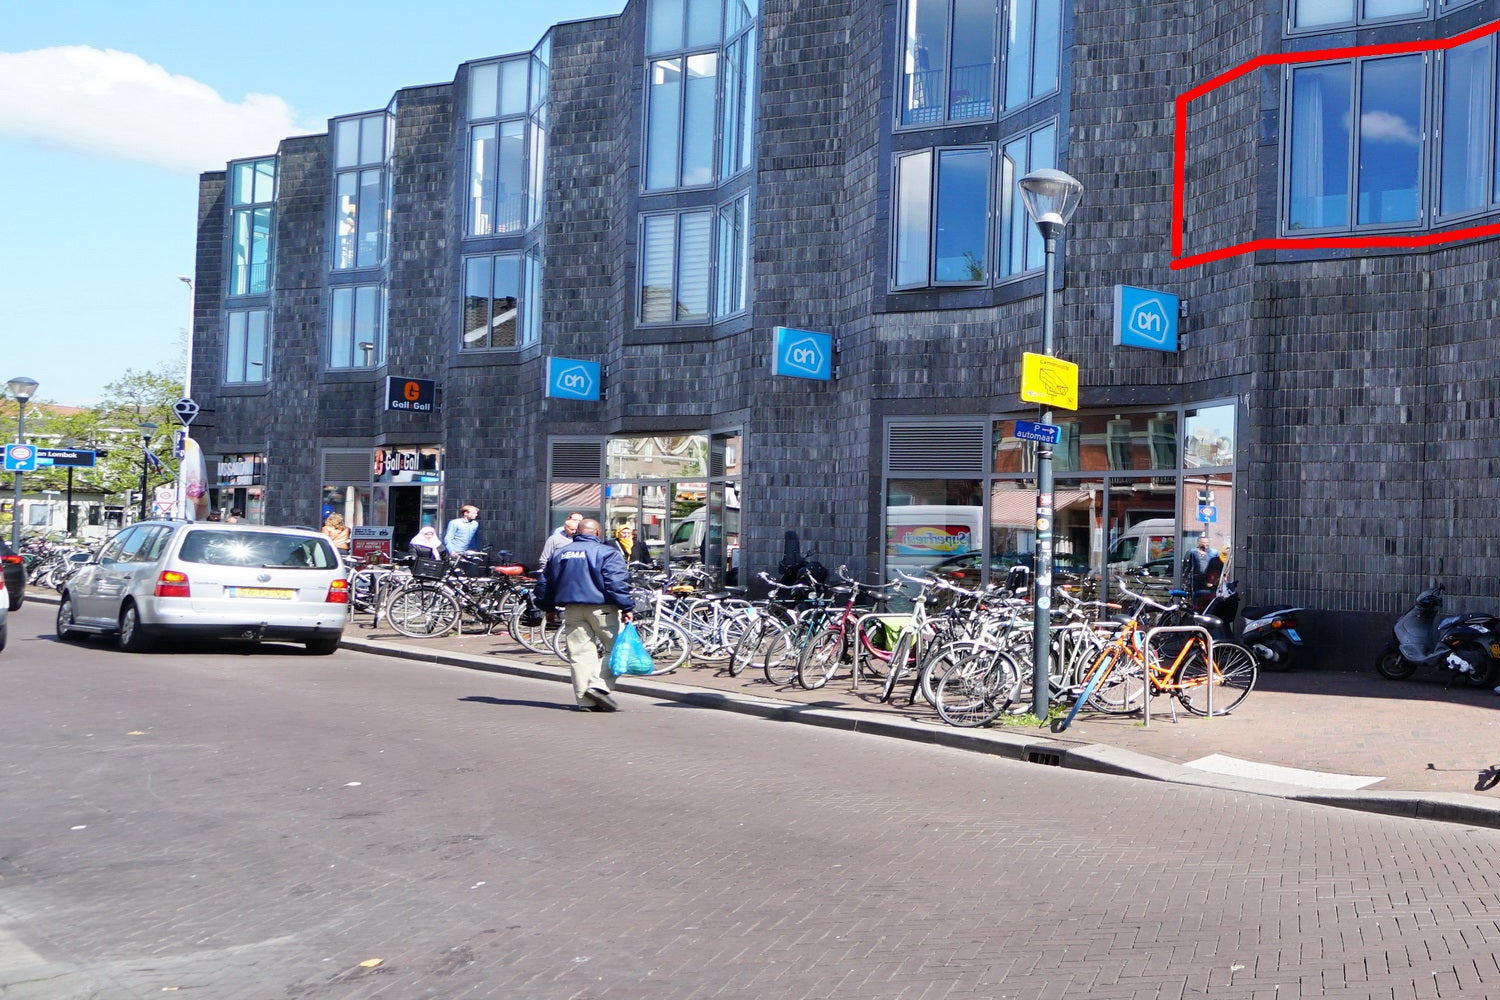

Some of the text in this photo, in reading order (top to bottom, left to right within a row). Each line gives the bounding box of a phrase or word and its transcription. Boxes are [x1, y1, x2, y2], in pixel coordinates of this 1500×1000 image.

[392, 401, 410, 409] Gall
[413, 402, 431, 411] Gall
[1016, 430, 1055, 443] automaat
[47, 451, 78, 459] Lombok
[386, 454, 400, 471] Gall
[404, 453, 420, 471] Gall
